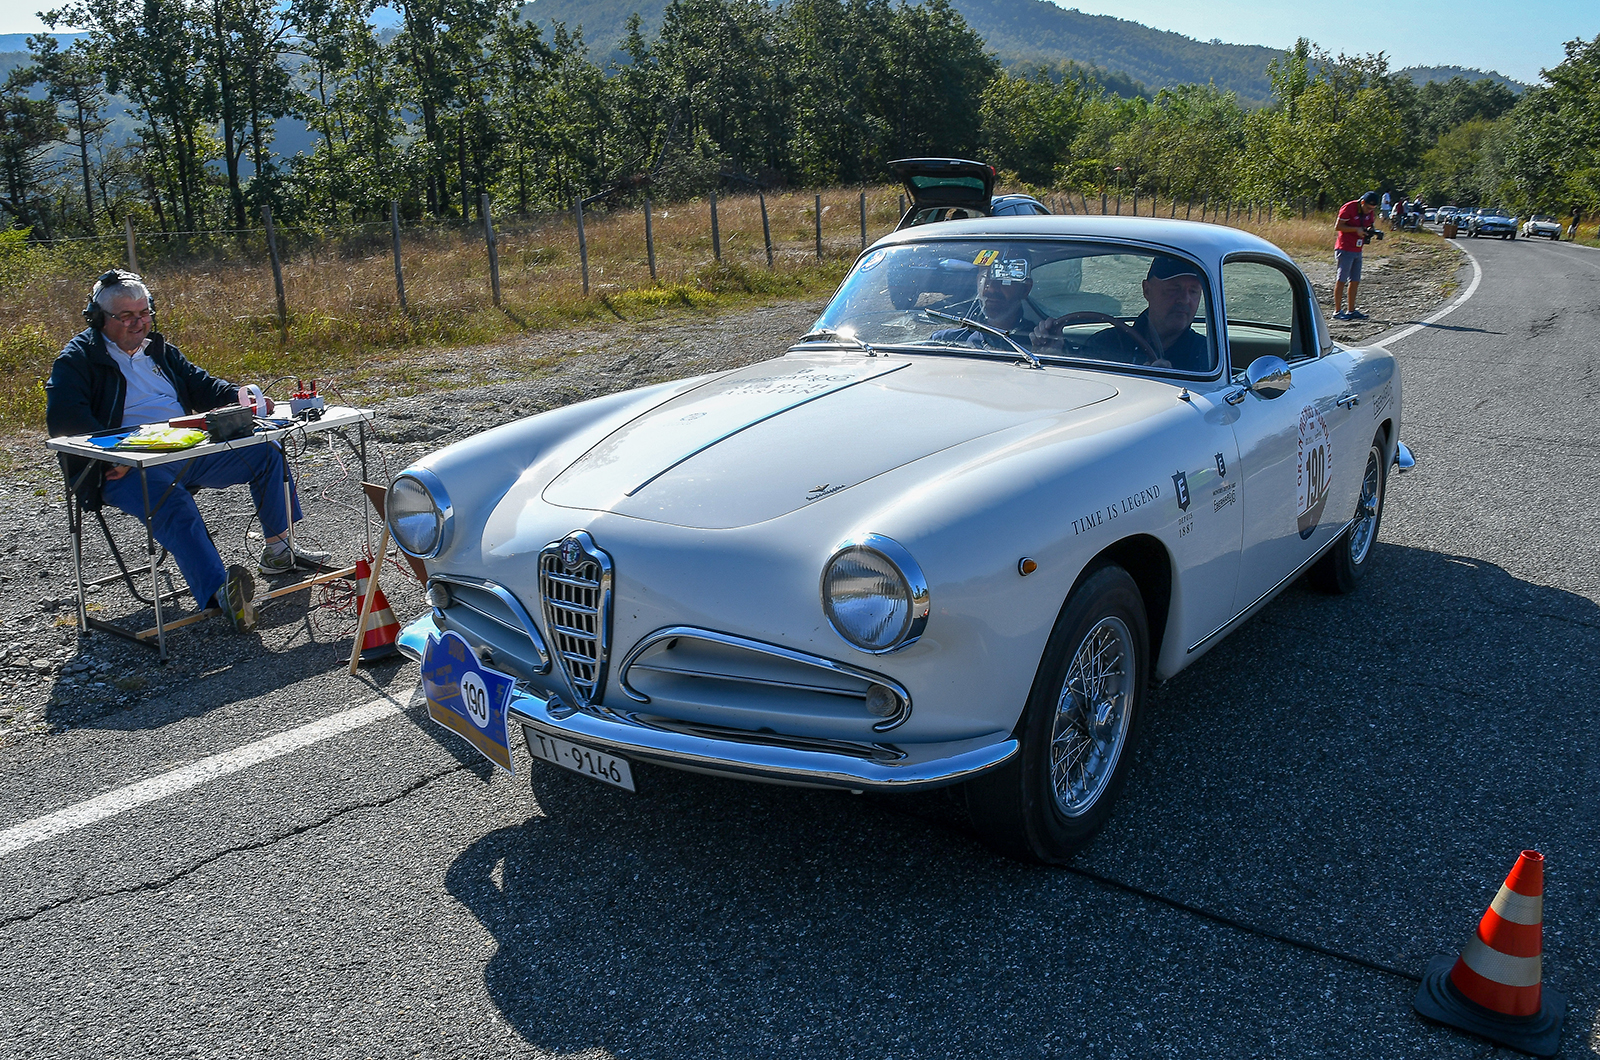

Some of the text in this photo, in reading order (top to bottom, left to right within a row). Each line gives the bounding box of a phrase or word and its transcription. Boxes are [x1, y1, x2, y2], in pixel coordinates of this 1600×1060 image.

[1305, 444, 1325, 509] 190
[1071, 484, 1161, 535] TIME IS LEGEND
[1178, 521, 1194, 538] 1887
[463, 680, 487, 721] 190
